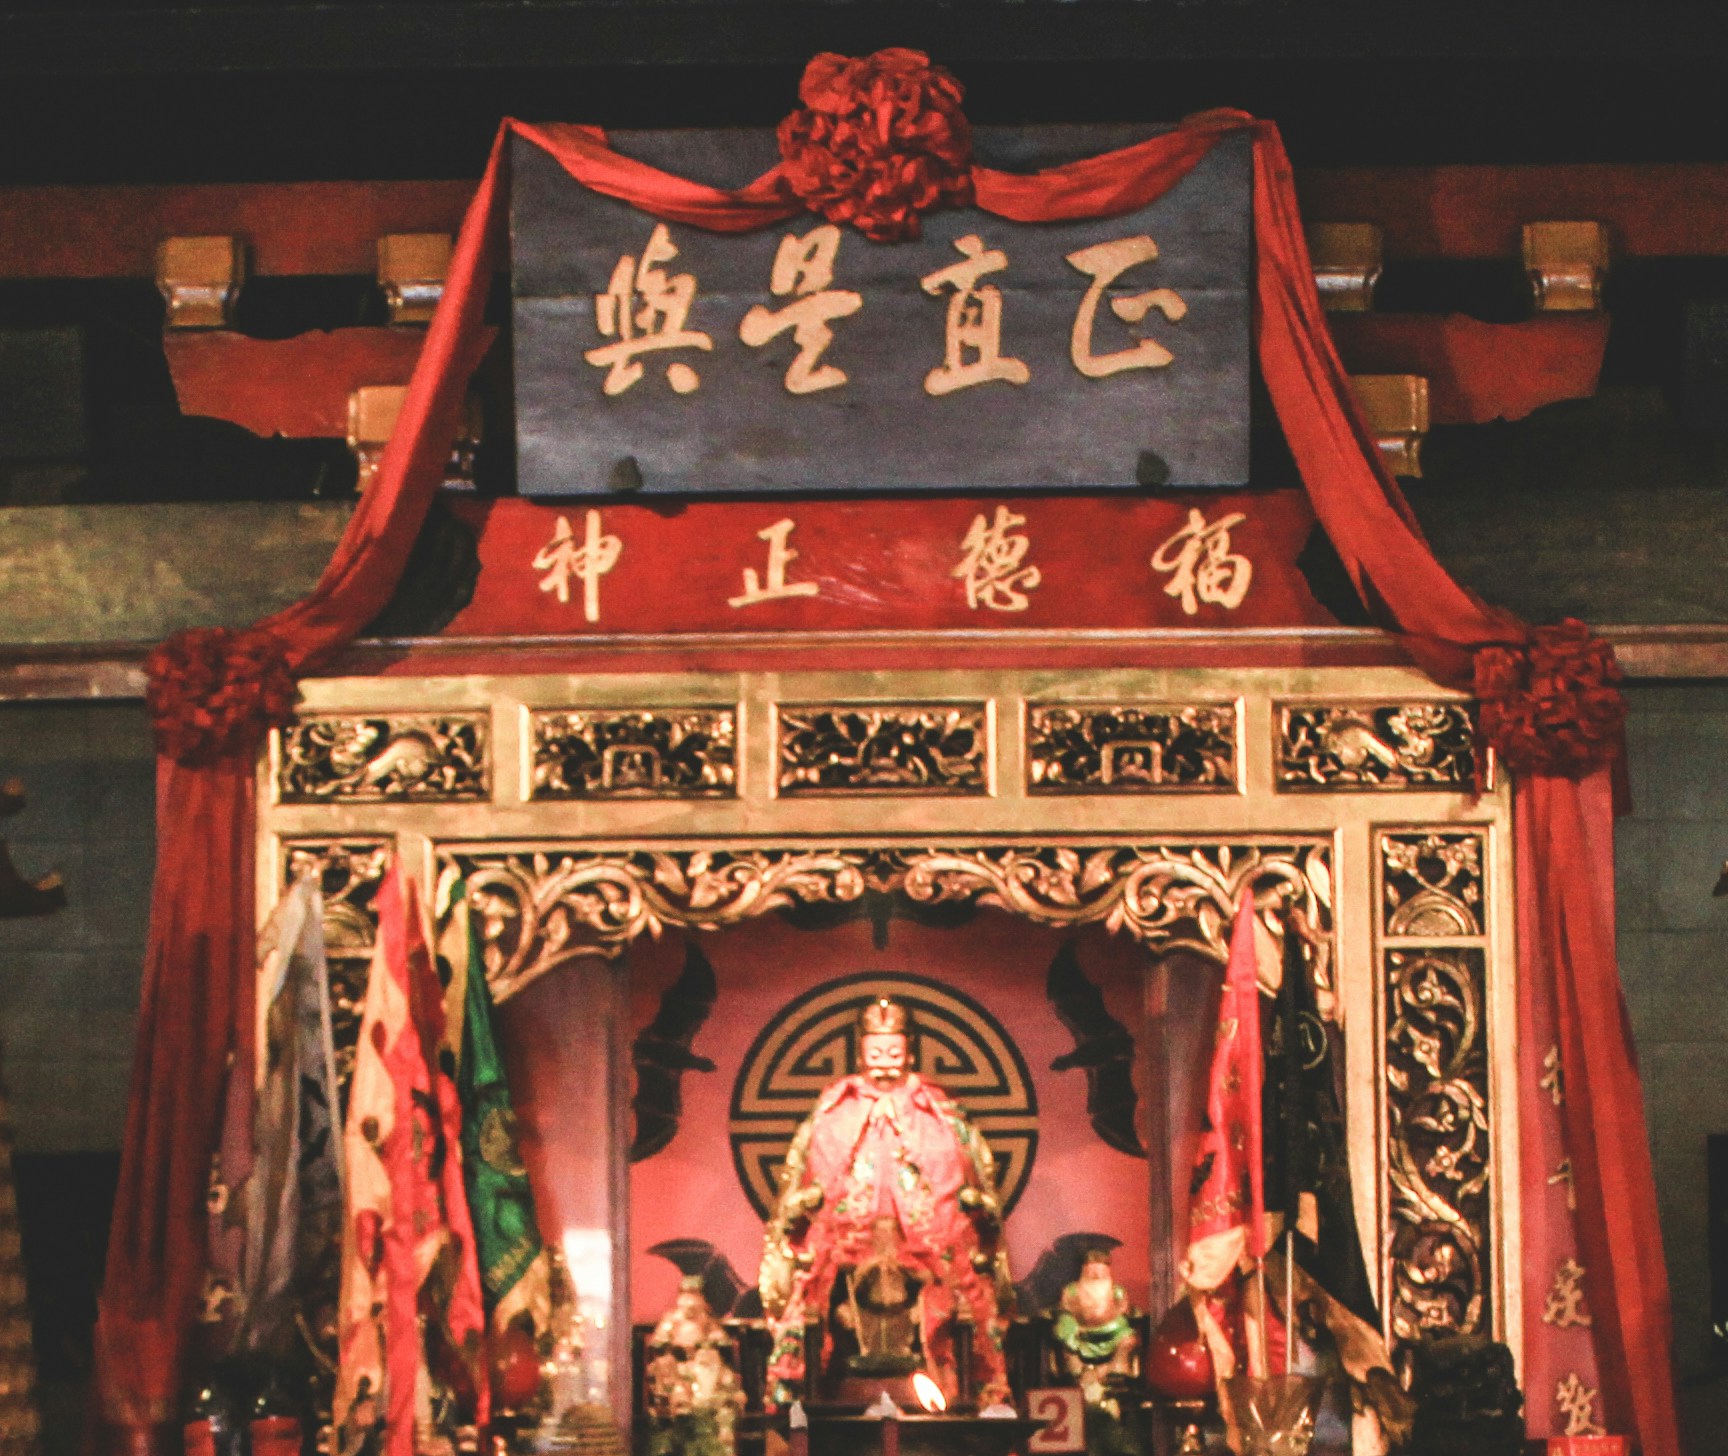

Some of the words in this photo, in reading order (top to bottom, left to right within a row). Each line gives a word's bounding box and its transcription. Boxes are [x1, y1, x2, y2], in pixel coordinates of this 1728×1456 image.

[532, 505, 1254, 623] 福德正神
[1038, 1395, 1069, 1442] 2
